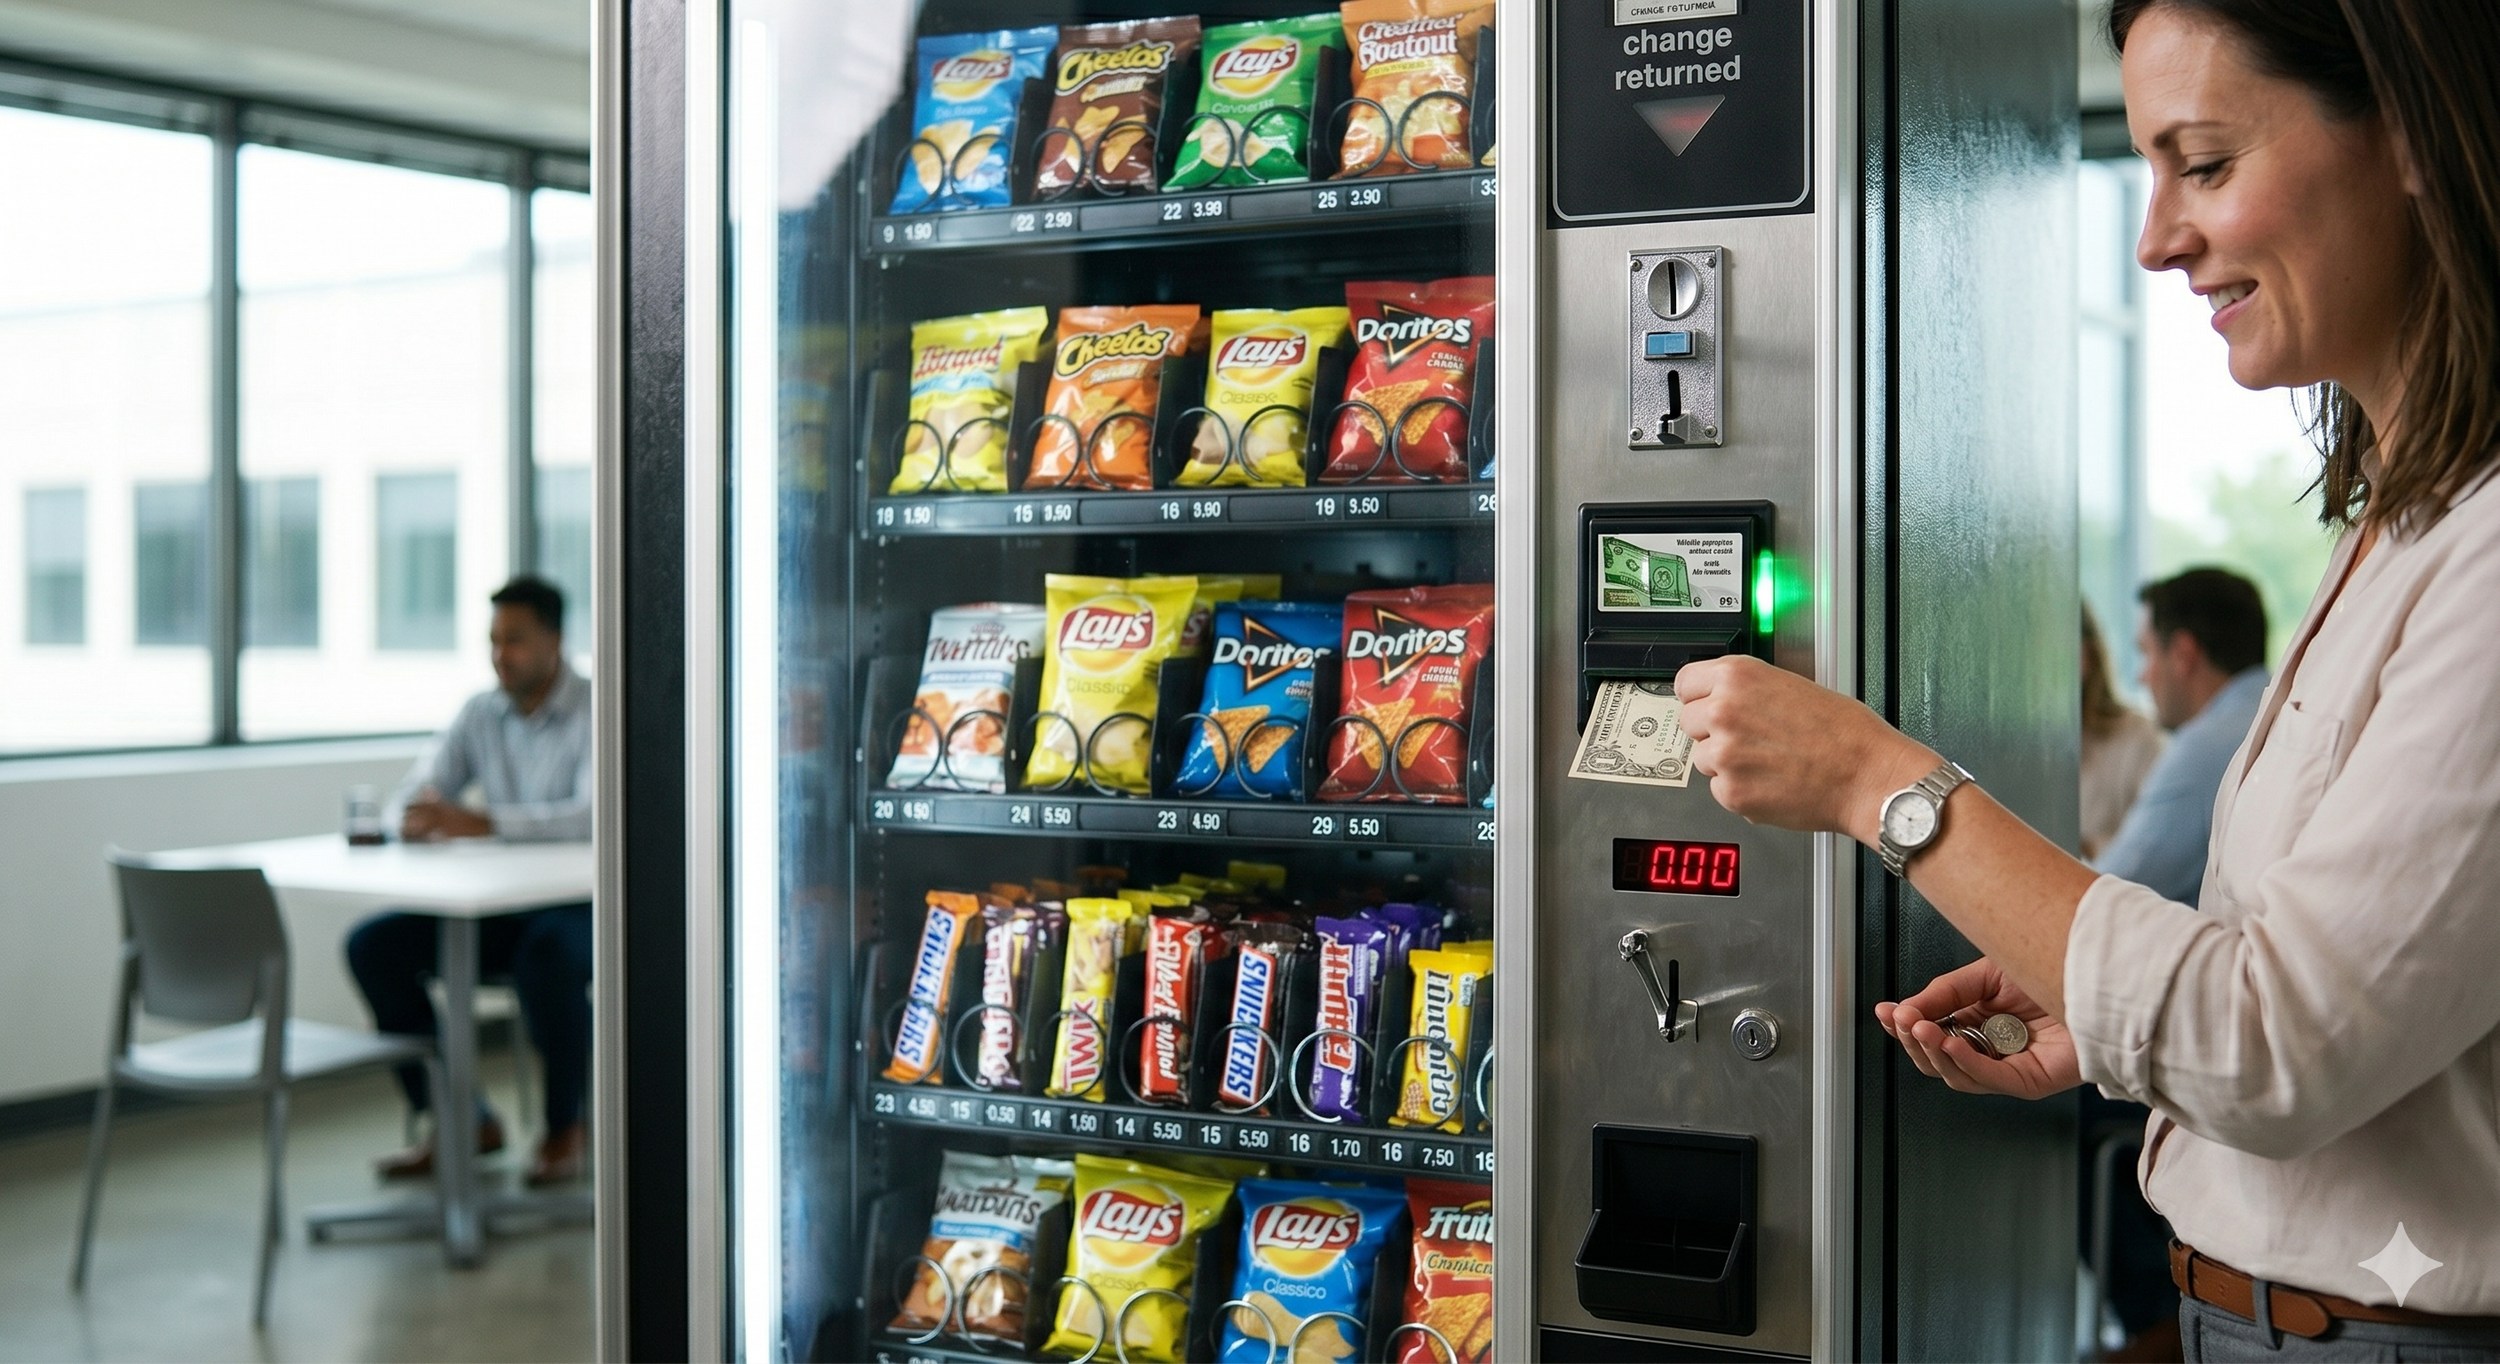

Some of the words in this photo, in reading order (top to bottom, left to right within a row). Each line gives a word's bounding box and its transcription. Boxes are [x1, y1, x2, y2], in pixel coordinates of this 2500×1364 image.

[1623, 27, 1733, 55] change
[1056, 43, 1170, 93] Cheetos
[1615, 54, 1741, 90] returned
[1317, 191, 1337, 210] 25
[1162, 202, 1182, 221] 22
[883, 225, 895, 243] 9
[1357, 316, 1472, 344] Doritos
[1056, 324, 1170, 377] Cheetos
[1060, 609, 1153, 651] Lay's
[1346, 628, 1467, 659] Doritos
[874, 800, 894, 820] 20
[1011, 805, 1031, 824] 24
[1044, 806, 1072, 825] 5.50
[1157, 811, 1177, 830] 23
[1192, 812, 1221, 831] 4.90
[1312, 816, 1333, 835] 29
[1349, 818, 1379, 836] 5.50
[1651, 846, 1736, 887] 0.00
[1226, 955, 1268, 1098] SNICKERS
[1064, 998, 1099, 1092] TWIX
[875, 1093, 895, 1113] 23
[950, 1101, 970, 1120] 15
[1032, 1109, 1052, 1129] 14
[1115, 1117, 1136, 1136] 14
[1200, 1125, 1221, 1145] 15
[1289, 1133, 1311, 1153] 16
[1381, 1142, 1403, 1162] 16
[1082, 1192, 1182, 1243] Lay's
[1255, 1205, 1358, 1250] Lay's
[1263, 1277, 1327, 1300] Classico
